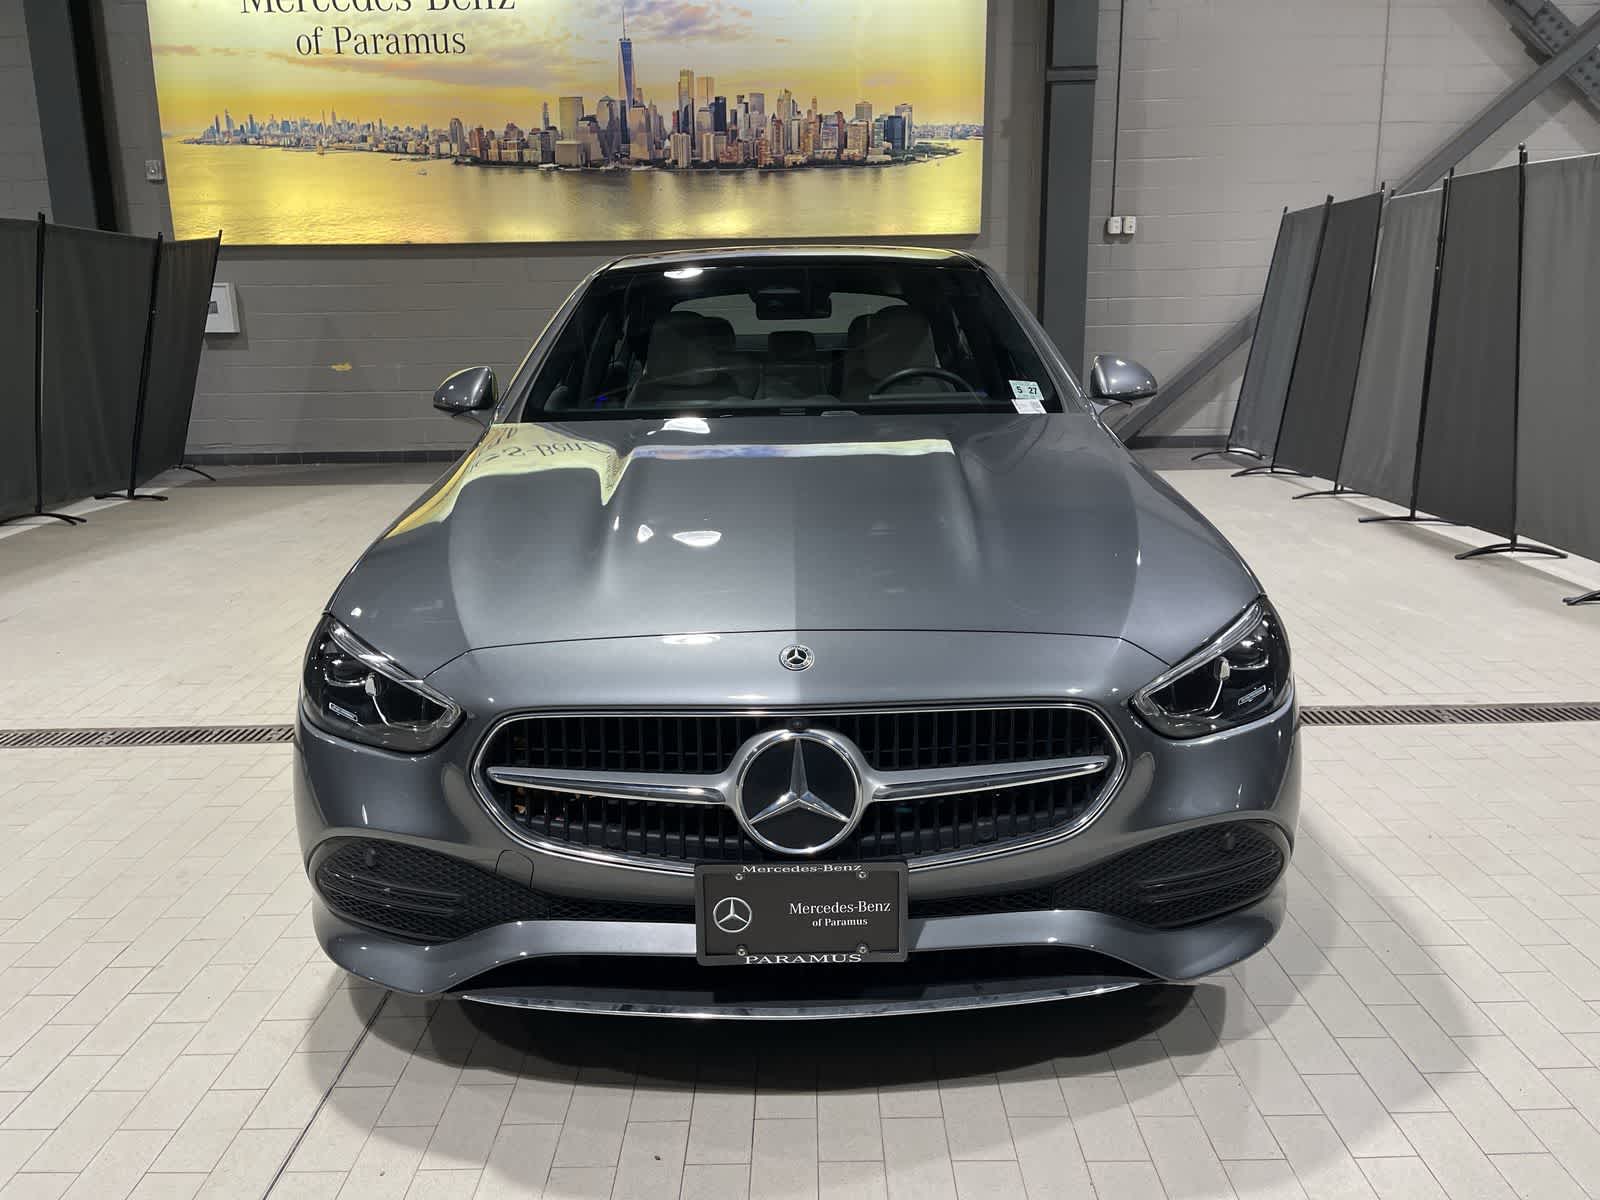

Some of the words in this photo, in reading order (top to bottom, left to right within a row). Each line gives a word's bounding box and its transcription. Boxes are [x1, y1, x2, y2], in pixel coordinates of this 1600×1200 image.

[296, 26, 323, 56] of
[332, 25, 467, 55] Paramus
[1016, 385, 1023, 394] 5
[1028, 386, 1037, 395] 27
[742, 864, 863, 873] Mercedes-Benz
[789, 900, 891, 915] Mercedes-Benz
[812, 918, 824, 927] of
[824, 917, 868, 927] Paramus
[744, 953, 863, 965] PARAMUS
